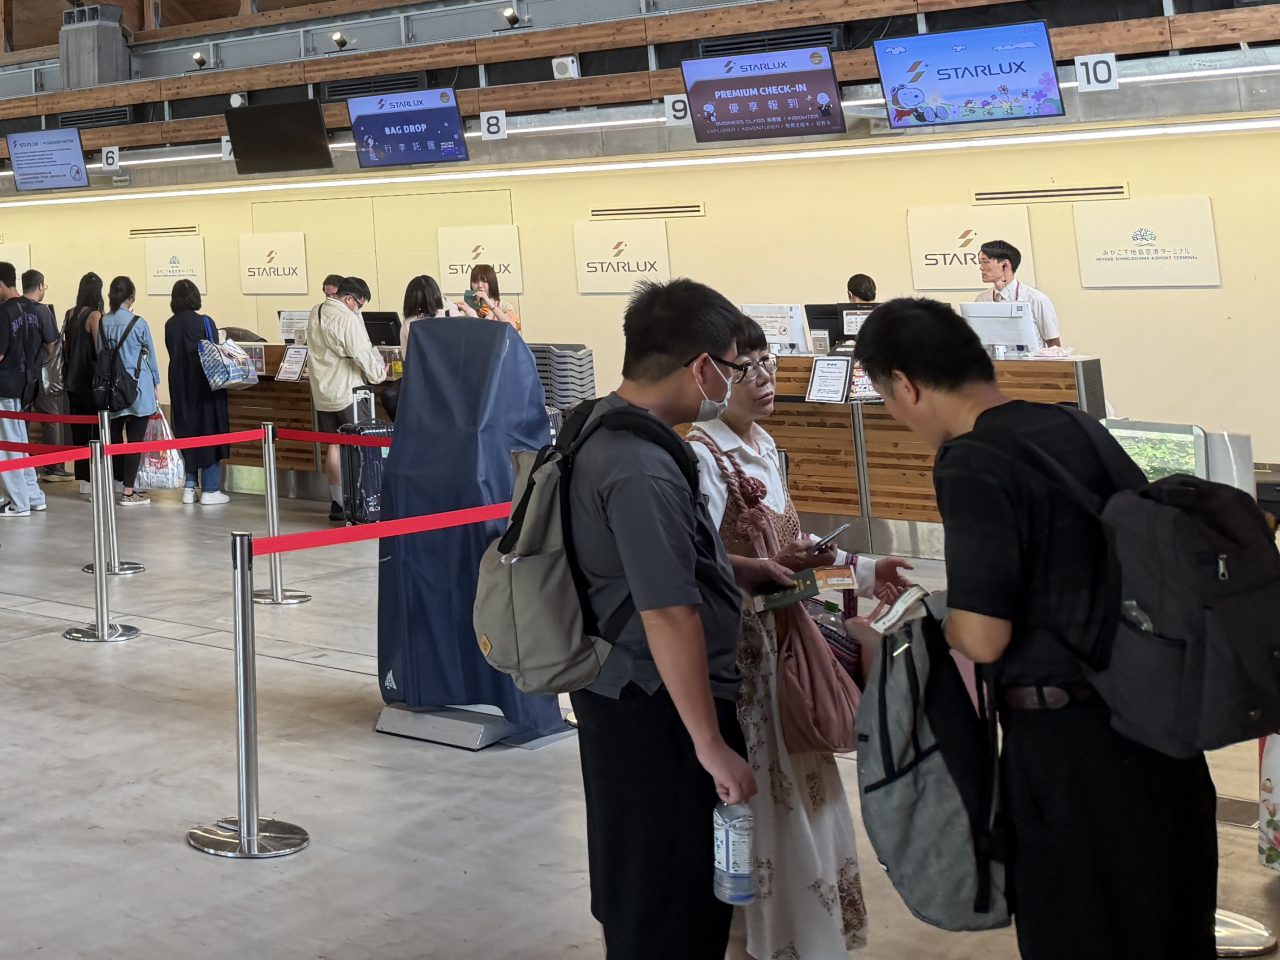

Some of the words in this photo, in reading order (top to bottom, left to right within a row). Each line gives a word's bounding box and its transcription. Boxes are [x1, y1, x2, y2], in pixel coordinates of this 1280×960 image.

[739, 61, 788, 73] STARLUX
[936, 60, 1028, 81] STARLUX
[1079, 60, 1112, 85] 10
[714, 87, 759, 100] PREMIUM
[759, 83, 807, 96] CHECK-IN
[389, 99, 425, 109] STARLUX
[671, 99, 688, 120] 9
[384, 126, 402, 135] BAG
[404, 123, 427, 134] DROP
[486, 115, 501, 135] 8
[105, 150, 115, 166] 6
[586, 260, 658, 273] STARLUX
[924, 252, 981, 266] STAR
[247, 266, 299, 277] STARLUX
